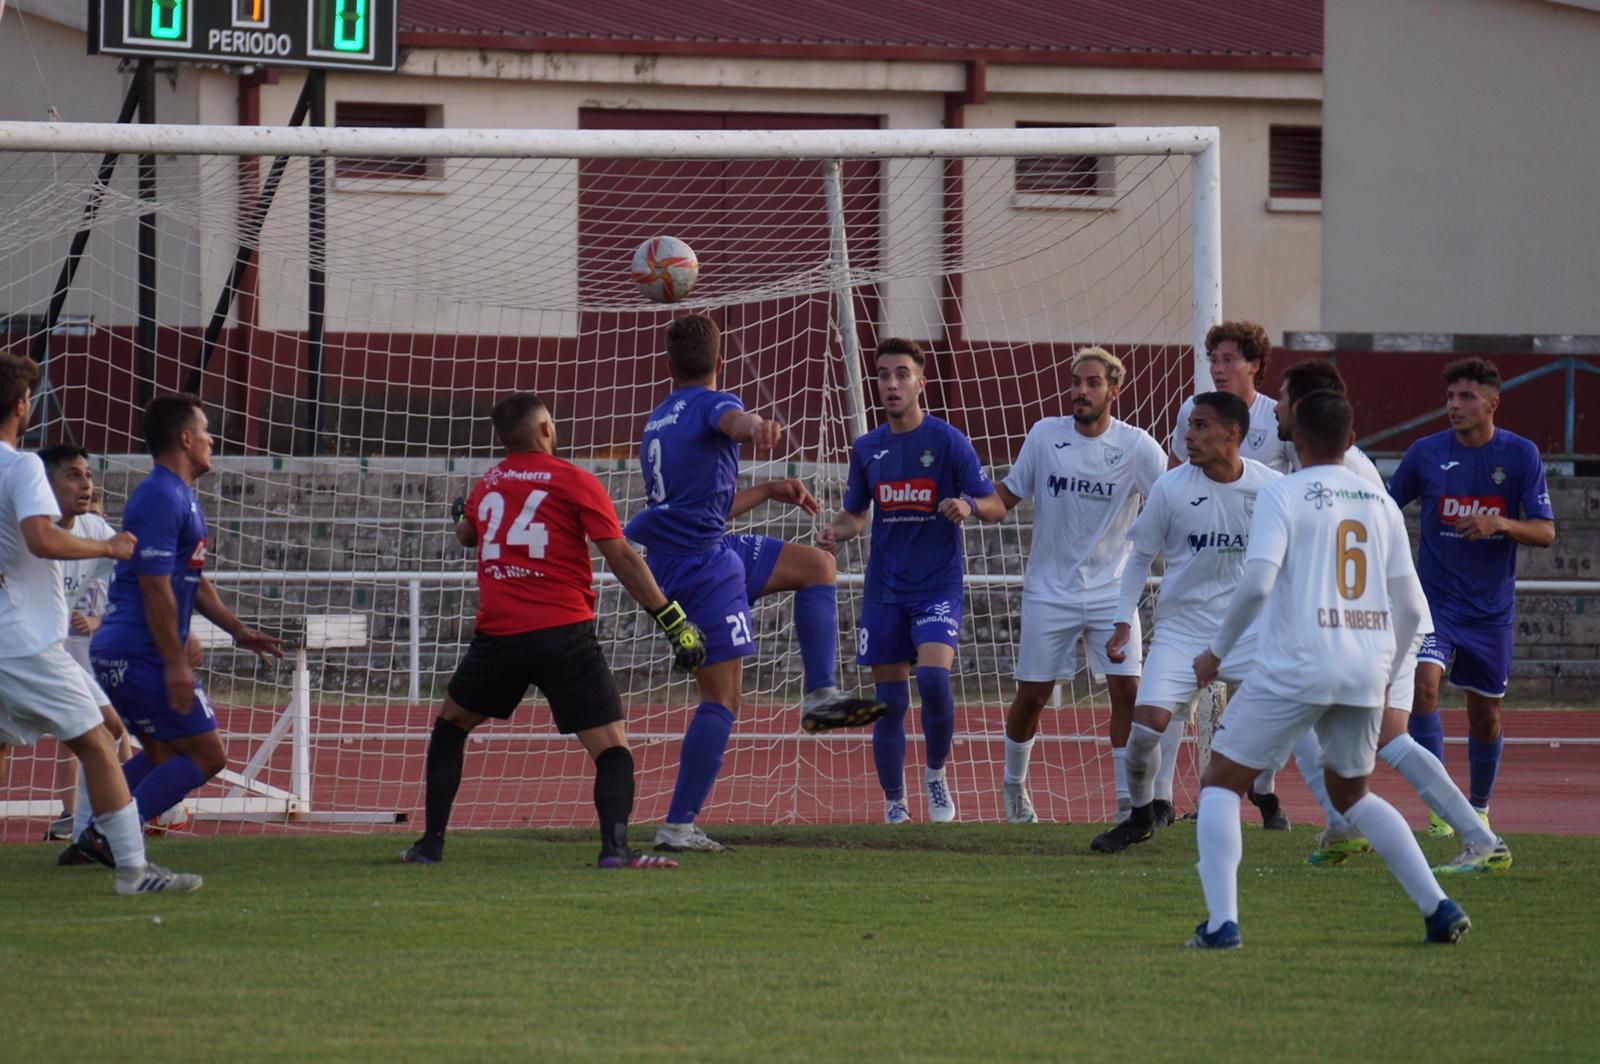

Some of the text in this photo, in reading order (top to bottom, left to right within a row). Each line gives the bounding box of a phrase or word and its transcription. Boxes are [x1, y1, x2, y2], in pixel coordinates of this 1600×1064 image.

[208, 29, 292, 56] PERIODO
[647, 438, 666, 503] 3
[880, 483, 932, 502] Dulca
[478, 489, 549, 561] 24
[1336, 518, 1368, 601] 6
[726, 611, 752, 646] 21
[1317, 608, 1389, 631] C.D. RIBERT
